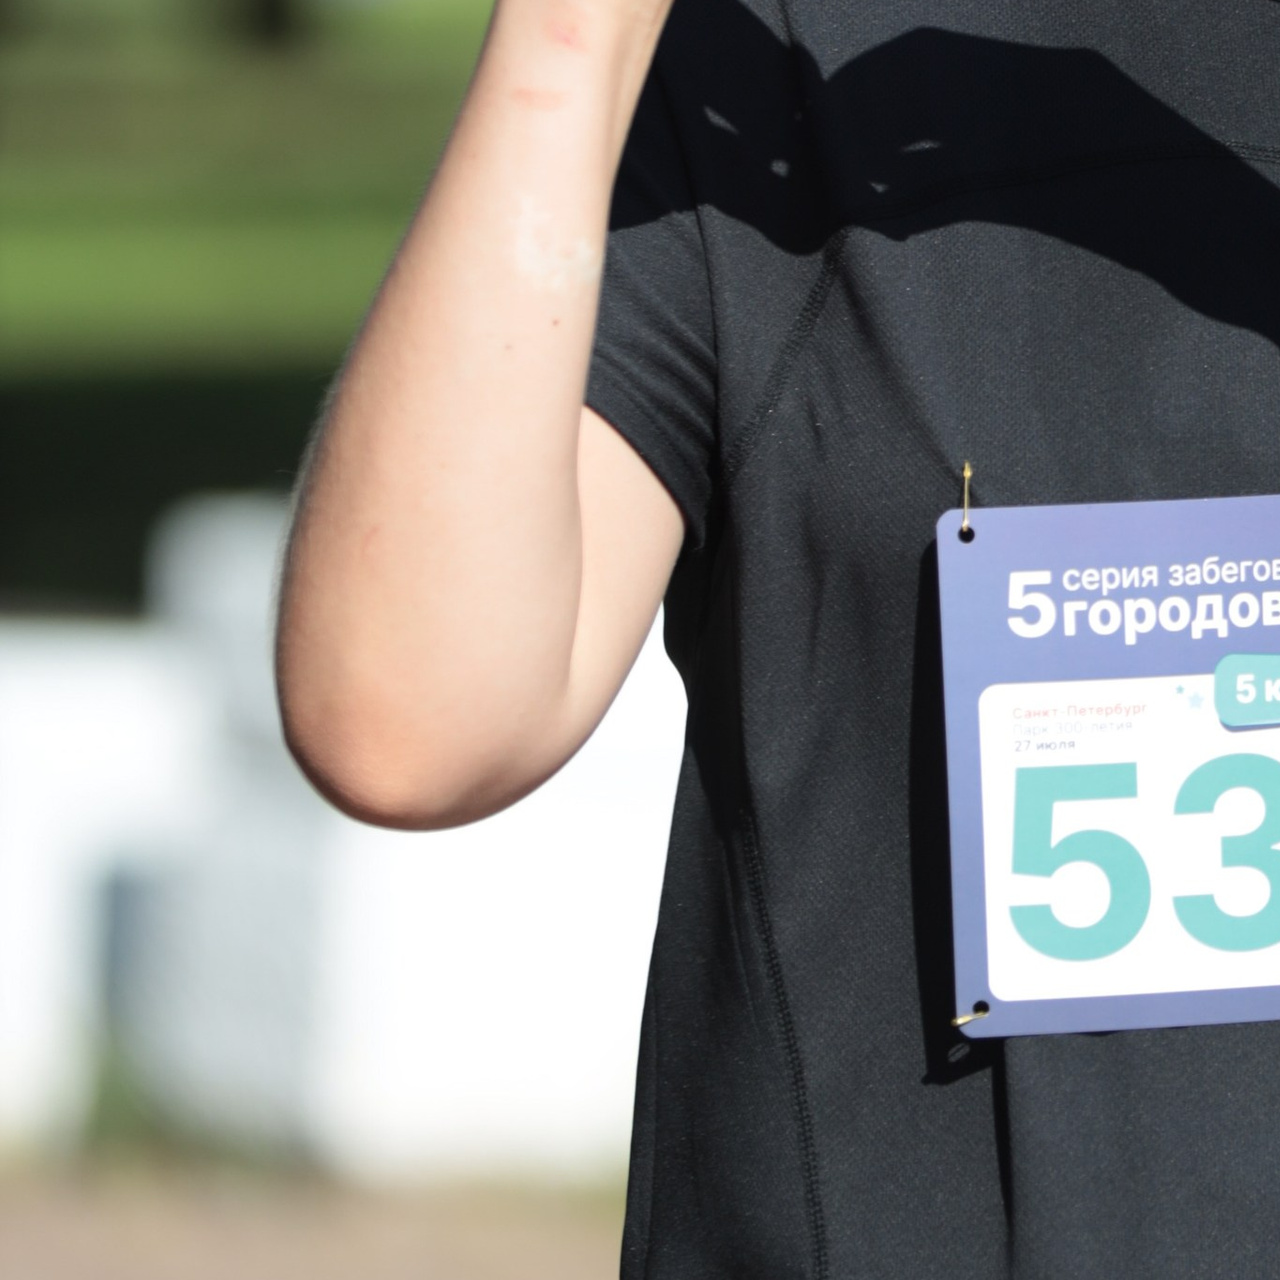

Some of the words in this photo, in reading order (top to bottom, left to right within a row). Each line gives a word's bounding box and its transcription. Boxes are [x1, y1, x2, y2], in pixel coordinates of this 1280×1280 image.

[1062, 563, 1160, 594] серия
[1007, 570, 1058, 638] 5
[1234, 674, 1257, 704] 5
[1012, 702, 1148, 720] Санкт-Петербург
[1013, 723, 1050, 737] Парк
[1014, 739, 1032, 752] 27
[1035, 739, 1077, 751] июля
